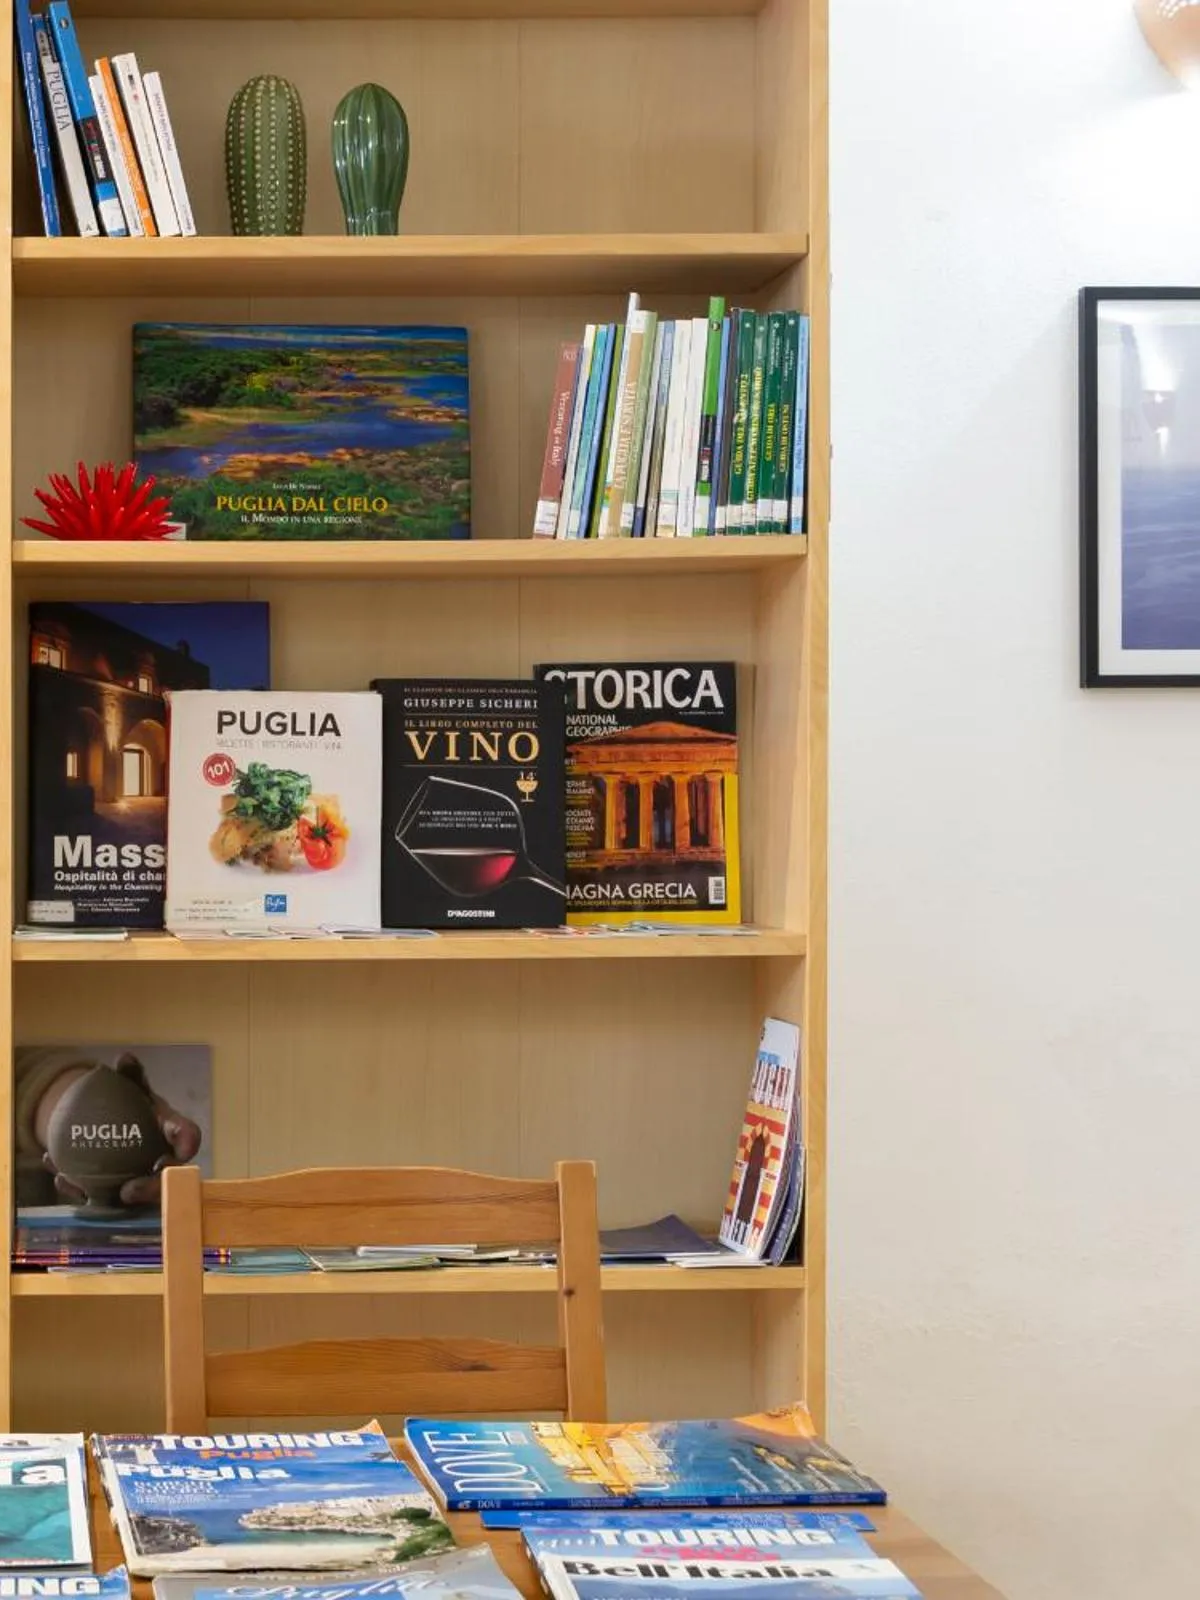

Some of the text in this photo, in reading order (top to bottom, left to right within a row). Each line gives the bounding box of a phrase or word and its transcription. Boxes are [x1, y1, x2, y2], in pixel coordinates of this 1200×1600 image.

[47, 69, 73, 132] PUGLIA
[216, 495, 389, 513] PUGLIA DAL CIELO
[404, 698, 538, 709] GIUSEPPE SICHERI
[217, 710, 341, 737] PUGLIA
[404, 719, 538, 729] IL LIBRO COMPLETO DEL
[566, 714, 618, 725] NATIONAL
[404, 730, 540, 763] VINO
[207, 761, 231, 778] 101
[53, 835, 166, 868] Mass
[54, 870, 167, 883] Ospitalità di cha
[628, 883, 697, 899] GRECIA
[71, 1123, 142, 1140] PUGLIA
[152, 1432, 363, 1449] TOURING
[423, 1431, 543, 1494] DOVE
[116, 1463, 292, 1481] Puglia
[591, 1529, 835, 1546] TOURING
[562, 1561, 836, 1579] Bell'Italia
